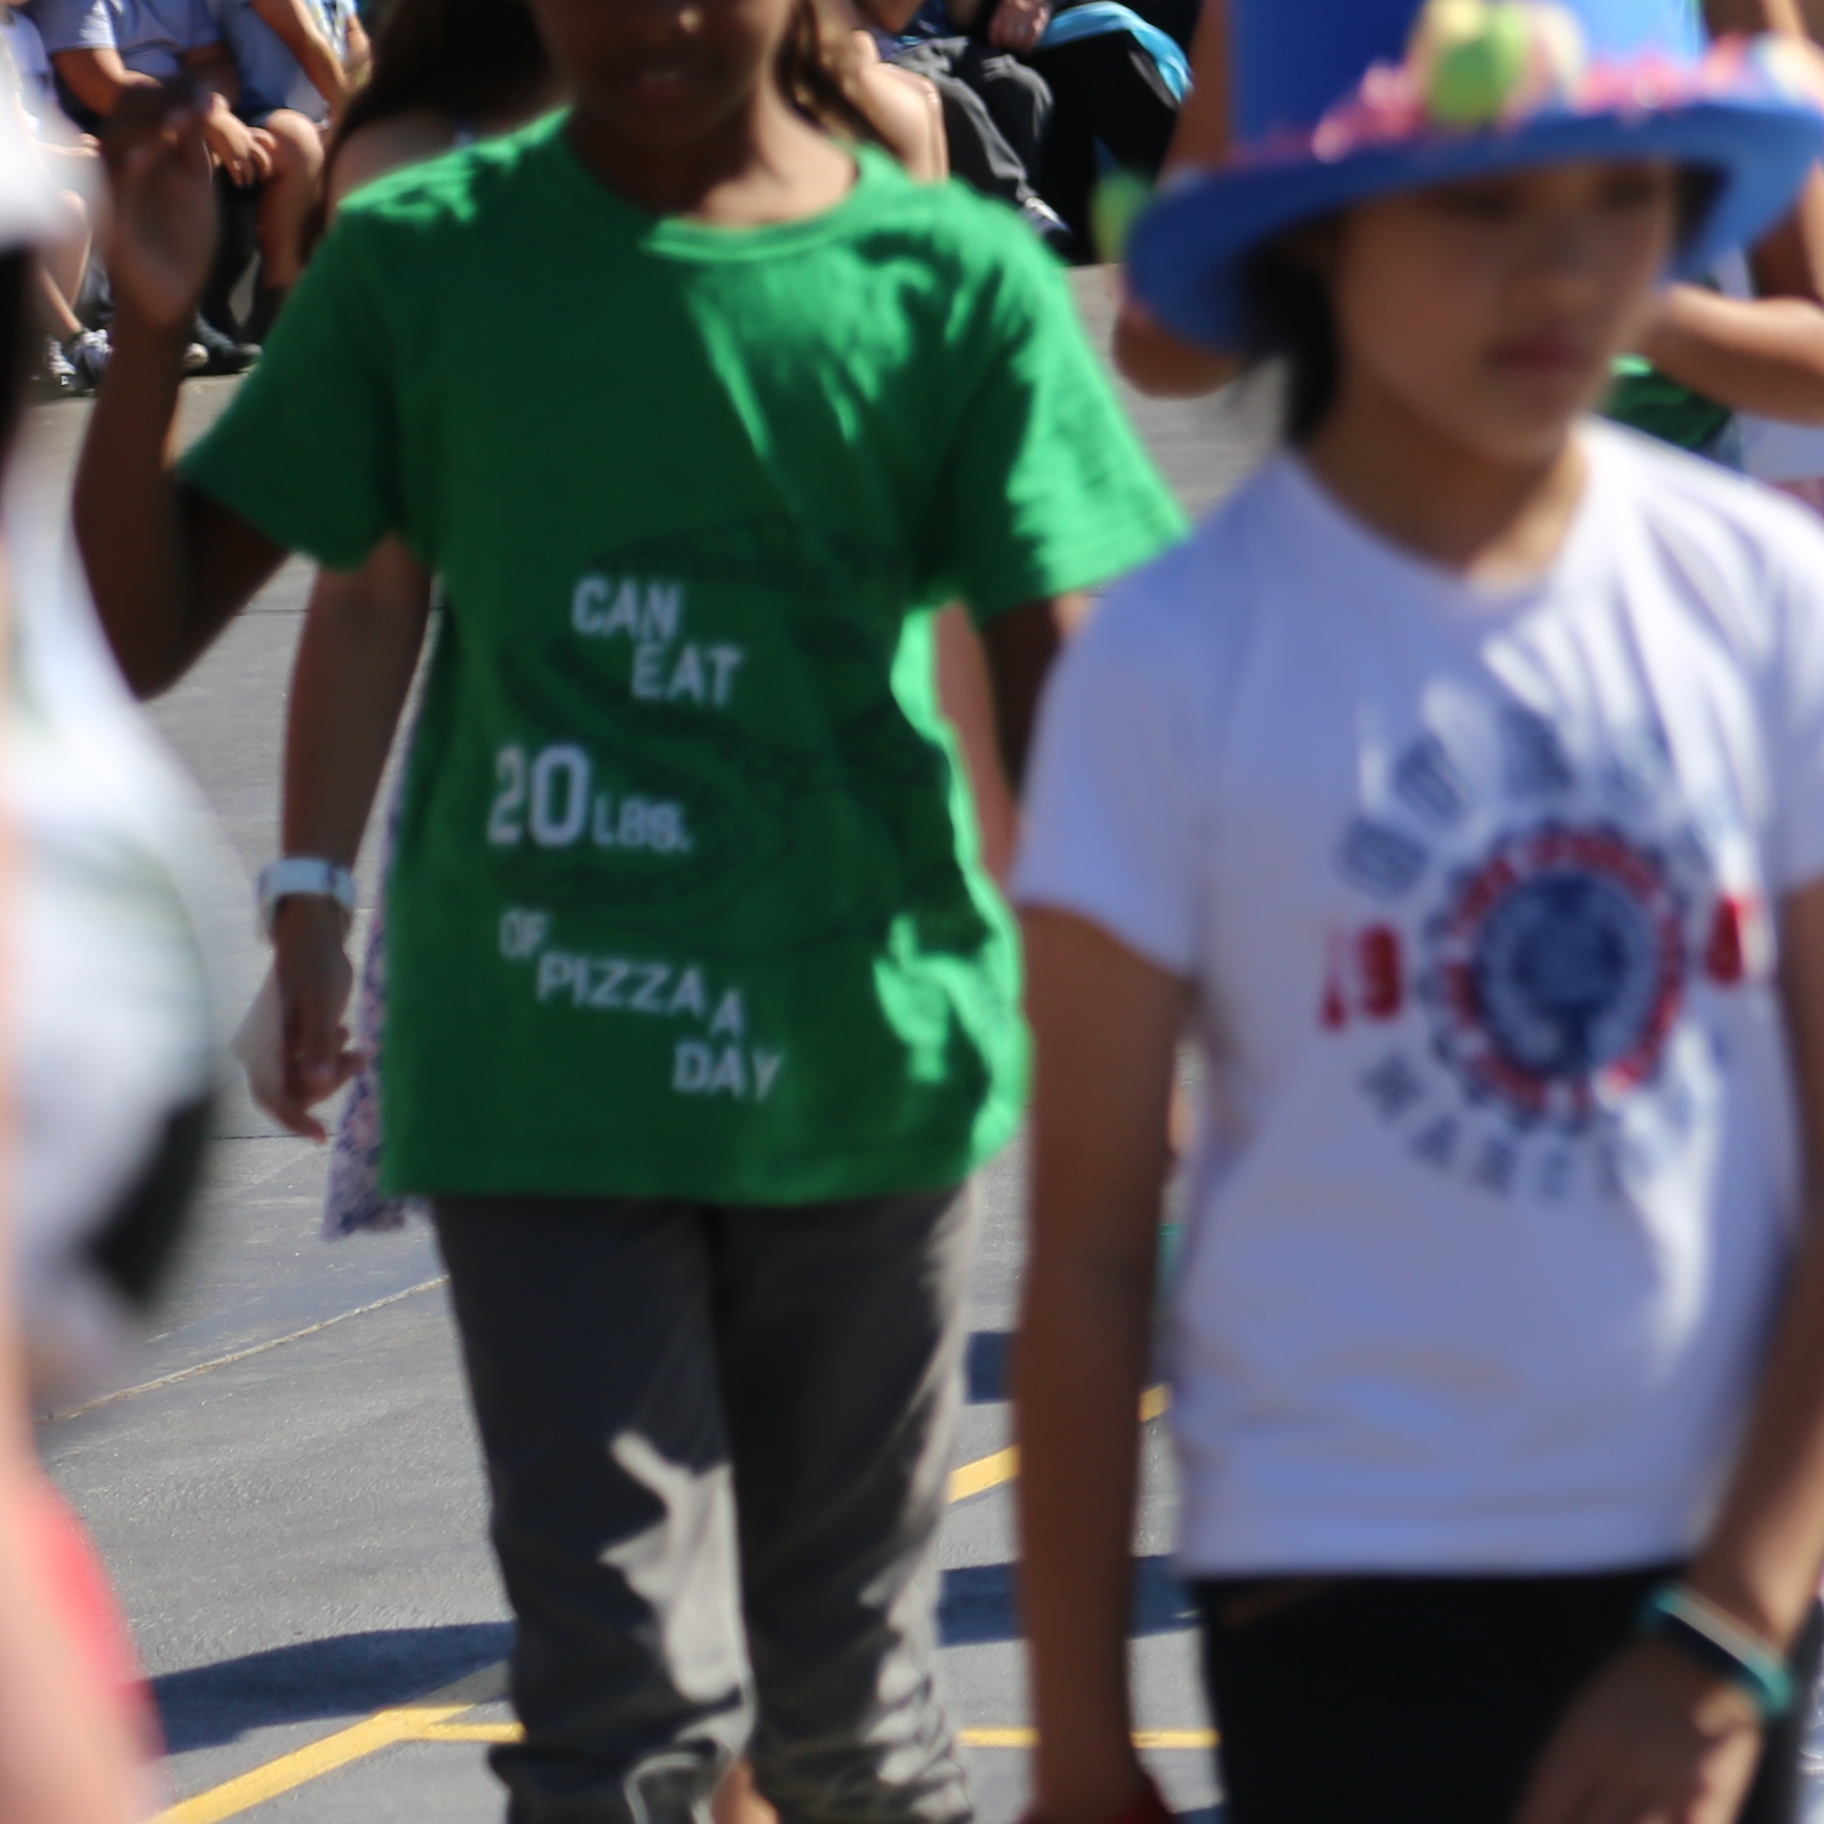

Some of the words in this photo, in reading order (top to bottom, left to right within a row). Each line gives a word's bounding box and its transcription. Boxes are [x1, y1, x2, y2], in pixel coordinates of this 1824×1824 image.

[570, 575, 682, 638] CAN
[630, 642, 744, 707] EAT
[487, 744, 590, 847] 20
[500, 909, 545, 959] OF
[537, 952, 705, 1017] PIZZA
[709, 989, 746, 1041] A
[672, 1042, 783, 1102] DAY
